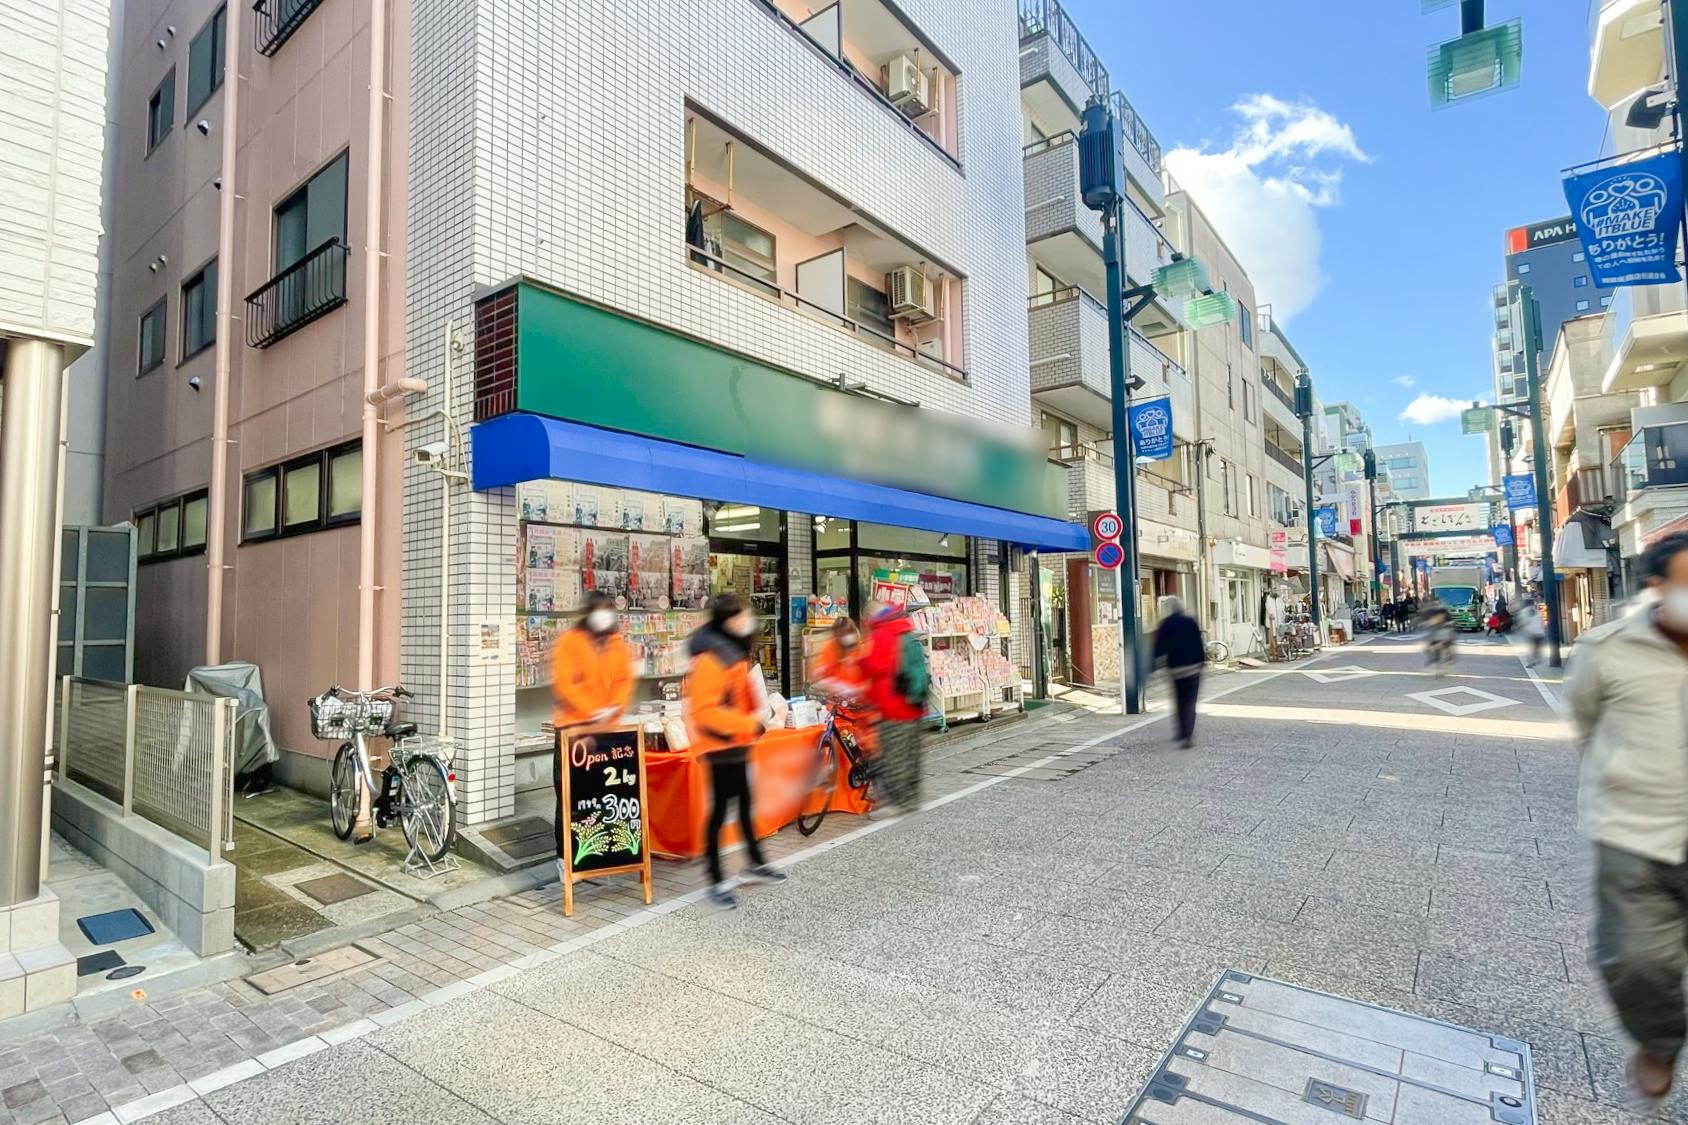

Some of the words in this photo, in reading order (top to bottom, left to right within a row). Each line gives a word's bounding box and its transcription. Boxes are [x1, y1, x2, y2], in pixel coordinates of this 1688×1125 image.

[1597, 208, 1653, 227] #MAKE
[1598, 218, 1652, 236] ITBLUE
[1533, 226, 1563, 241] APA
[1588, 232, 1665, 256] ありがとう!
[1101, 521, 1116, 534] 30
[571, 740, 609, 771] Open
[611, 745, 635, 760] 記念
[602, 793, 640, 824] 300
